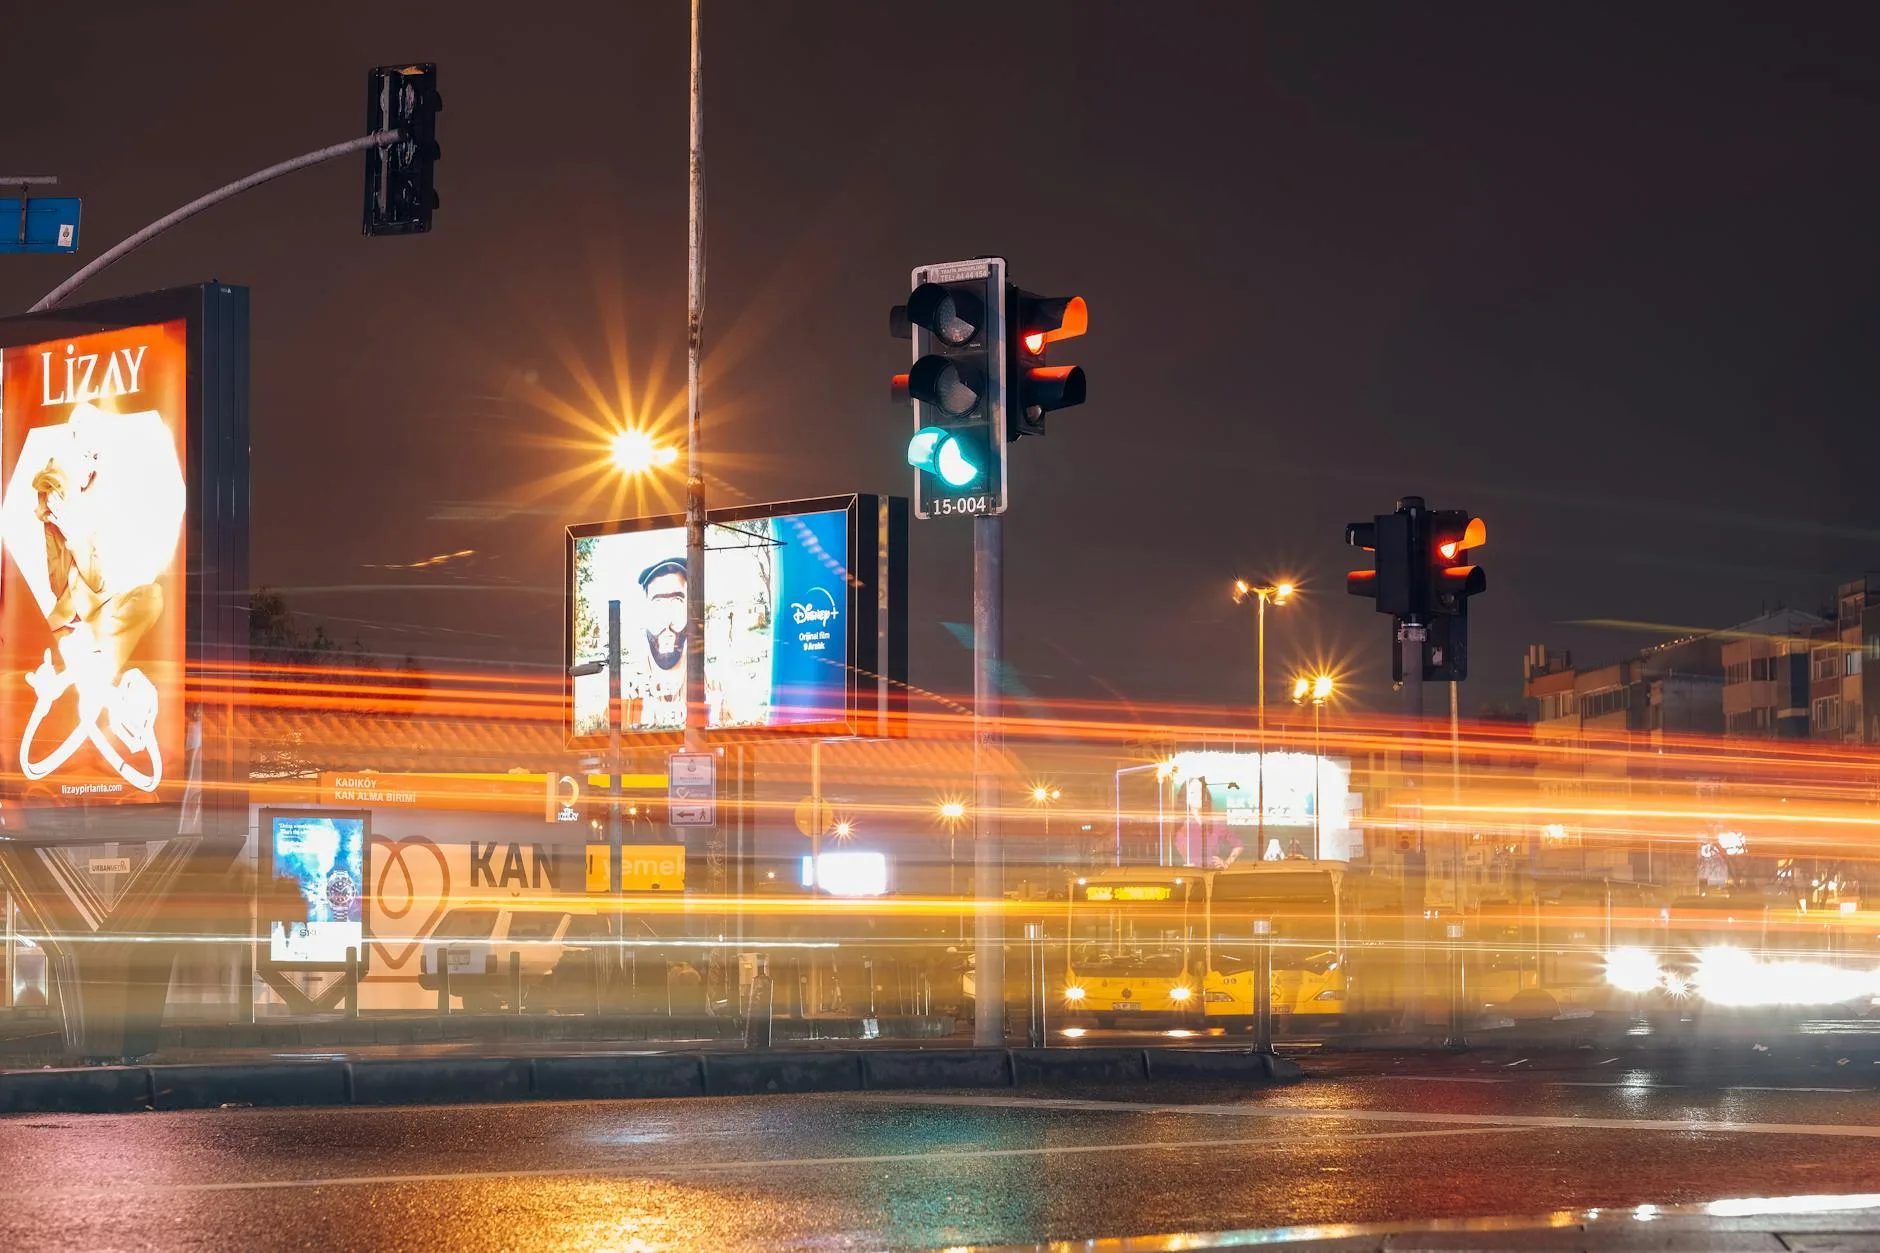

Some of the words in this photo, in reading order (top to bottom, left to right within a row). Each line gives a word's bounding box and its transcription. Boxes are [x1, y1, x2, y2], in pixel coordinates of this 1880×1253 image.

[933, 496, 986, 515] 15-004
[335, 777, 377, 788] KADIKÖY
[61, 784, 123, 795] lizaypirlanta.com
[335, 790, 355, 801] KAN
[357, 791, 384, 802] ALMA
[470, 841, 561, 888] KAN
